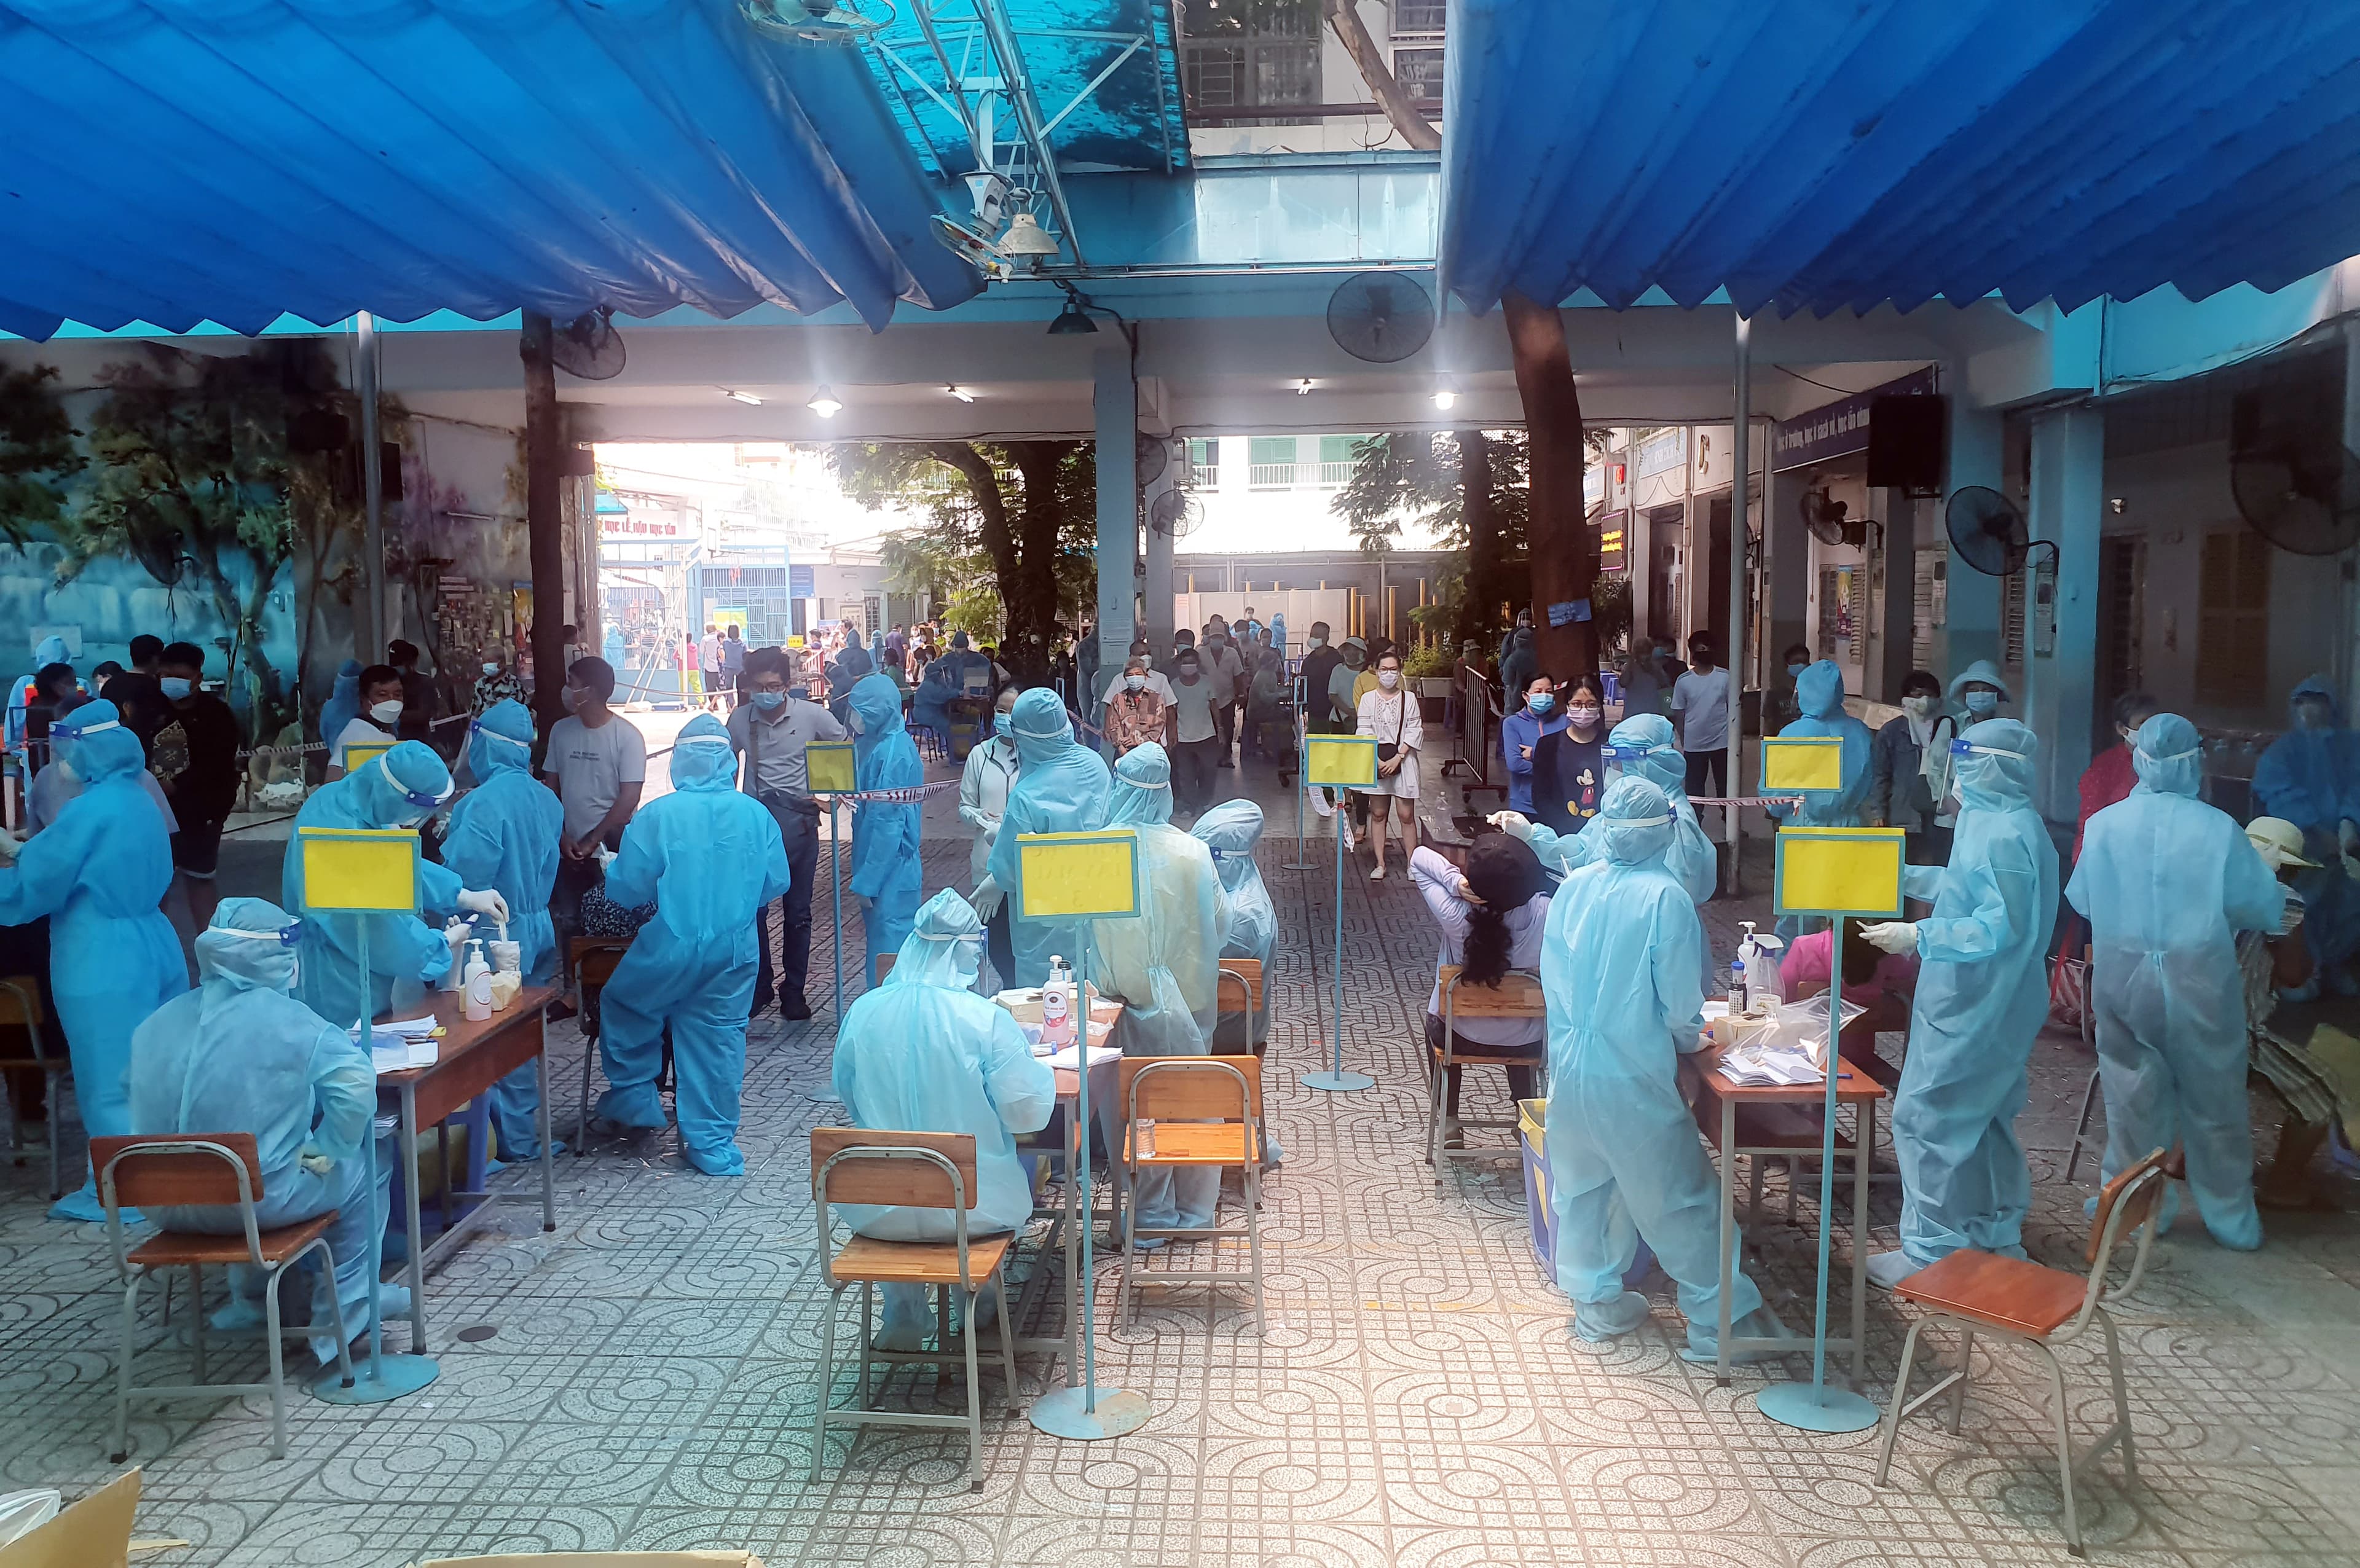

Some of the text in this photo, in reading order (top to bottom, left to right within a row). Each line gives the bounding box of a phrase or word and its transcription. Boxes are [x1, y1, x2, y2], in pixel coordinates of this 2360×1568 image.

[604, 520, 620, 535] HỌC
[650, 523, 663, 537] HỌC
[664, 522, 676, 535] VĂN
